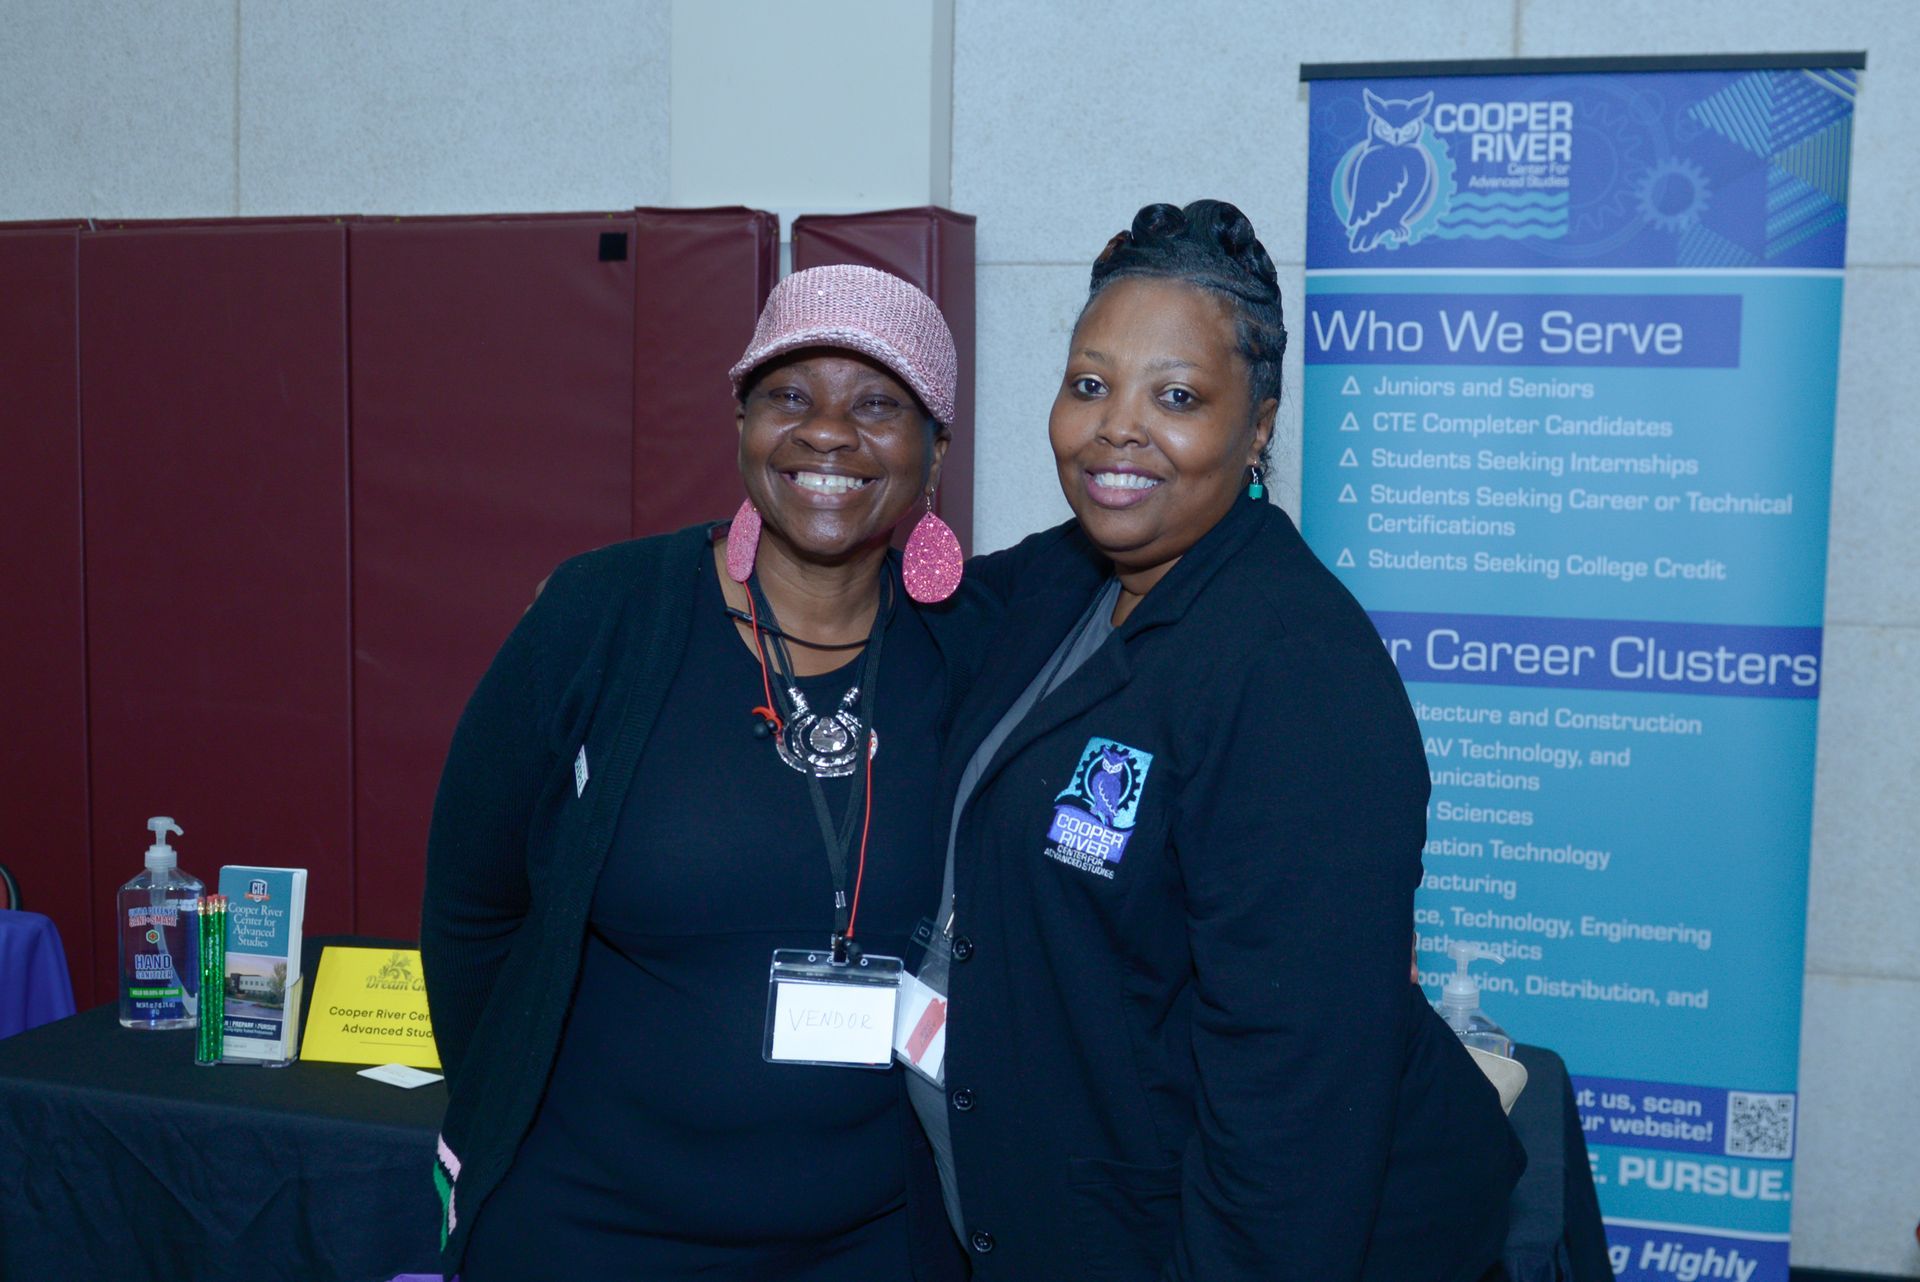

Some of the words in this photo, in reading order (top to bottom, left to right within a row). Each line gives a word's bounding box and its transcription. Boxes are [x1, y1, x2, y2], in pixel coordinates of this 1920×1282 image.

[1434, 102, 1572, 133] COOPER
[1471, 132, 1571, 162] RIVER
[1468, 175, 1524, 187] Advanced
[1526, 175, 1569, 188] Studies
[1507, 162, 1547, 175] Center
[1312, 310, 1423, 353] Who
[1440, 311, 1523, 353] We
[1541, 311, 1683, 355] Serve
[1373, 375, 1456, 397] Juniors
[1462, 377, 1501, 398] and
[1509, 377, 1594, 399] Seniors
[1372, 411, 1416, 433] CTE
[1422, 412, 1540, 436] Completer
[1546, 414, 1673, 437] Candidates
[1371, 448, 1471, 470] Students
[1477, 450, 1563, 477] Seeking
[1571, 451, 1699, 478] Internships
[1370, 484, 1470, 507] Students
[1476, 486, 1562, 512] Seeking
[1568, 489, 1648, 512] Career
[1654, 496, 1681, 512] or
[1686, 492, 1793, 515] Technical
[1367, 513, 1515, 537] Certifications
[1368, 548, 1467, 572] Students
[1474, 551, 1560, 578] Seeking
[1566, 555, 1648, 581] College
[1654, 557, 1727, 580] Credit
[1427, 629, 1595, 676] Career
[1610, 636, 1817, 687] Clusters
[1415, 701, 1502, 724] itecture
[1509, 708, 1549, 727] and
[1555, 709, 1702, 735] Construction
[1424, 737, 1453, 757] AV
[1459, 739, 1583, 770] Technology,
[1588, 747, 1631, 767] and
[1430, 767, 1541, 791] unications
[1436, 800, 1534, 827] Sciences
[1056, 813, 1125, 849] COOPER
[1057, 844, 1088, 861] CENTER
[1087, 854, 1105, 867] FOR
[1058, 830, 1110, 860] RIVER
[1490, 838, 1611, 871] Technology
[1044, 847, 1083, 868] ADVANCED
[1082, 861, 1115, 880] STUDIES
[252, 882, 264, 895] CTE
[1421, 869, 1517, 900] facturing
[228, 902, 258, 917] Cooper
[261, 905, 283, 917] River
[233, 913, 262, 926] Center
[264, 916, 276, 927] for
[232, 924, 275, 938] Advanced
[238, 935, 269, 948] Studies
[1450, 906, 1575, 938] Technology,
[1581, 916, 1712, 950] Engineering
[135, 954, 172, 969] HAND
[1526, 975, 1661, 1007] Distribution,
[1667, 988, 1709, 1010] and
[329, 1006, 374, 1019] Cooper
[376, 1009, 406, 1020] River
[788, 1007, 873, 1031] VENDOR
[341, 1023, 404, 1036] Advanced
[406, 1027, 434, 1038] Stud
[1601, 1092, 1637, 1114] us,
[1643, 1096, 1702, 1117] scan
[1609, 1115, 1713, 1142] website!
[1618, 1155, 1791, 1201] PURSUE.
[1639, 1240, 1757, 1282] Highly
